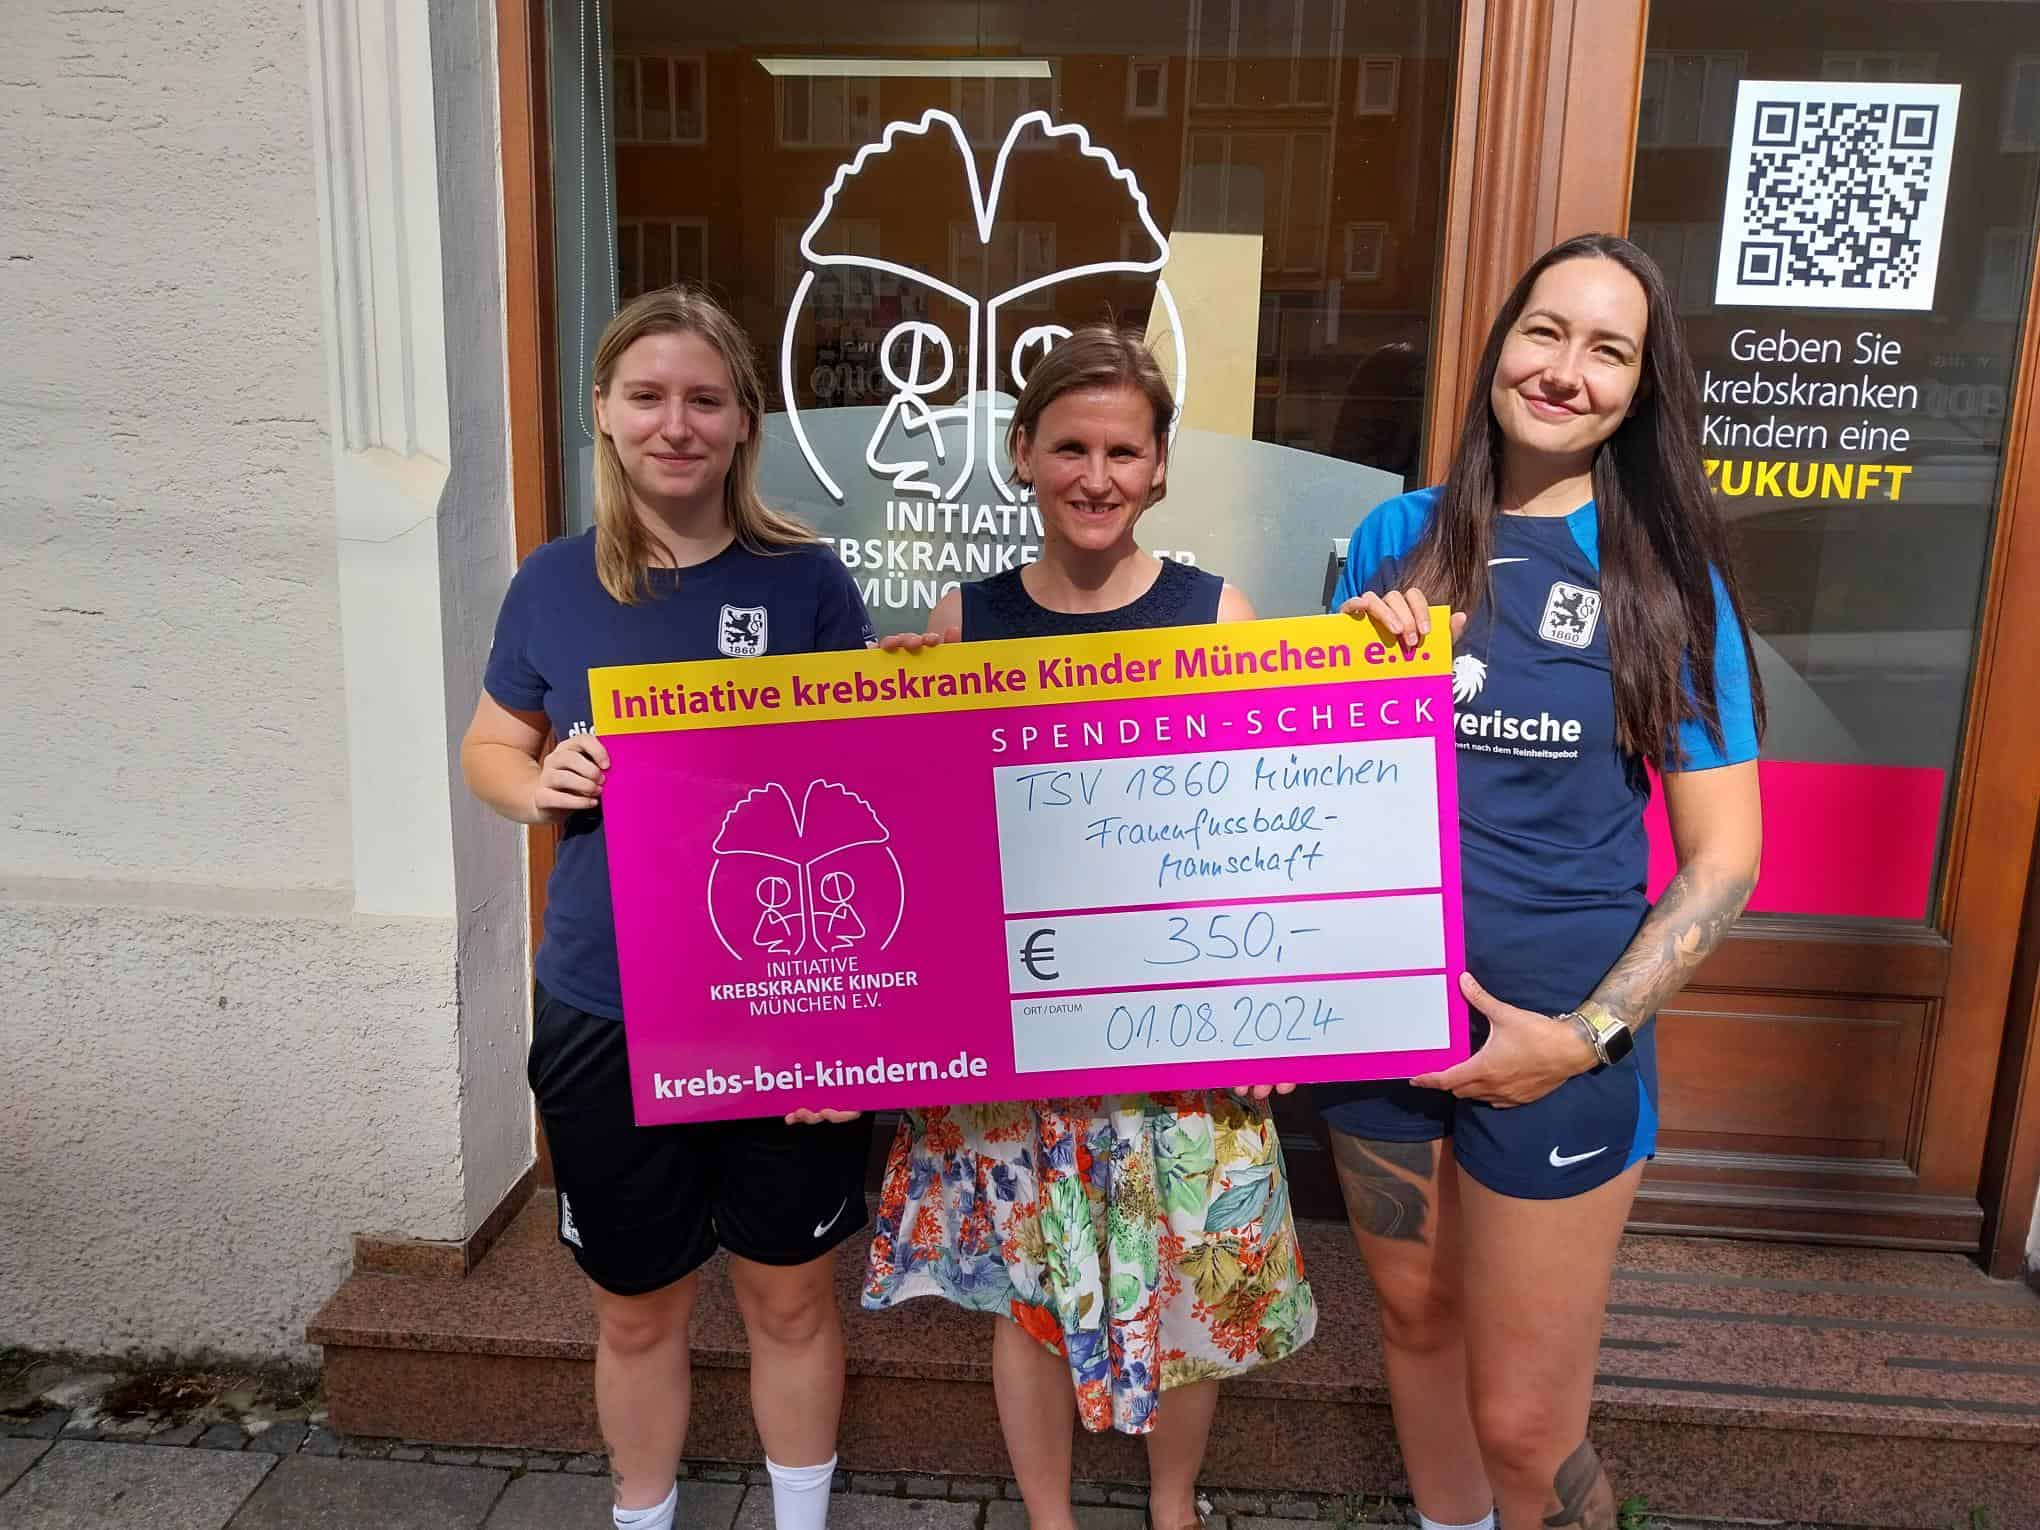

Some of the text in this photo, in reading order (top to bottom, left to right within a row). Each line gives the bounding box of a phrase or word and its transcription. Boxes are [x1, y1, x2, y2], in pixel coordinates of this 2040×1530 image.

[1730, 328, 1842, 364] Geben
[1853, 331, 1902, 366] Sie
[1703, 369, 1919, 409] krebskranken
[1702, 414, 1910, 451] Kindern eine
[729, 646, 756, 655] 1860
[1551, 629, 1580, 643] 1860
[611, 680, 781, 720] Initiative
[792, 661, 1027, 707] krebskranke
[1038, 654, 1163, 689] Kinder
[1174, 639, 1351, 678] München
[991, 697, 1436, 753] SPENDEN-SCHECK
[1454, 709, 1582, 742] erische
[1471, 744, 1491, 752] nach
[1493, 745, 1511, 754] dem
[1016, 755, 1400, 811] TSV 1860 München
[766, 956, 859, 977] INITIATIVE
[1020, 928, 1060, 981] €
[709, 970, 919, 1001] KREBSKRANKE KINDER
[749, 992, 882, 1017] MÜNCHEN E.V.
[1106, 995, 1344, 1051] 01.08.2024
[653, 1051, 988, 1099] krebs-bei-kindern.de
